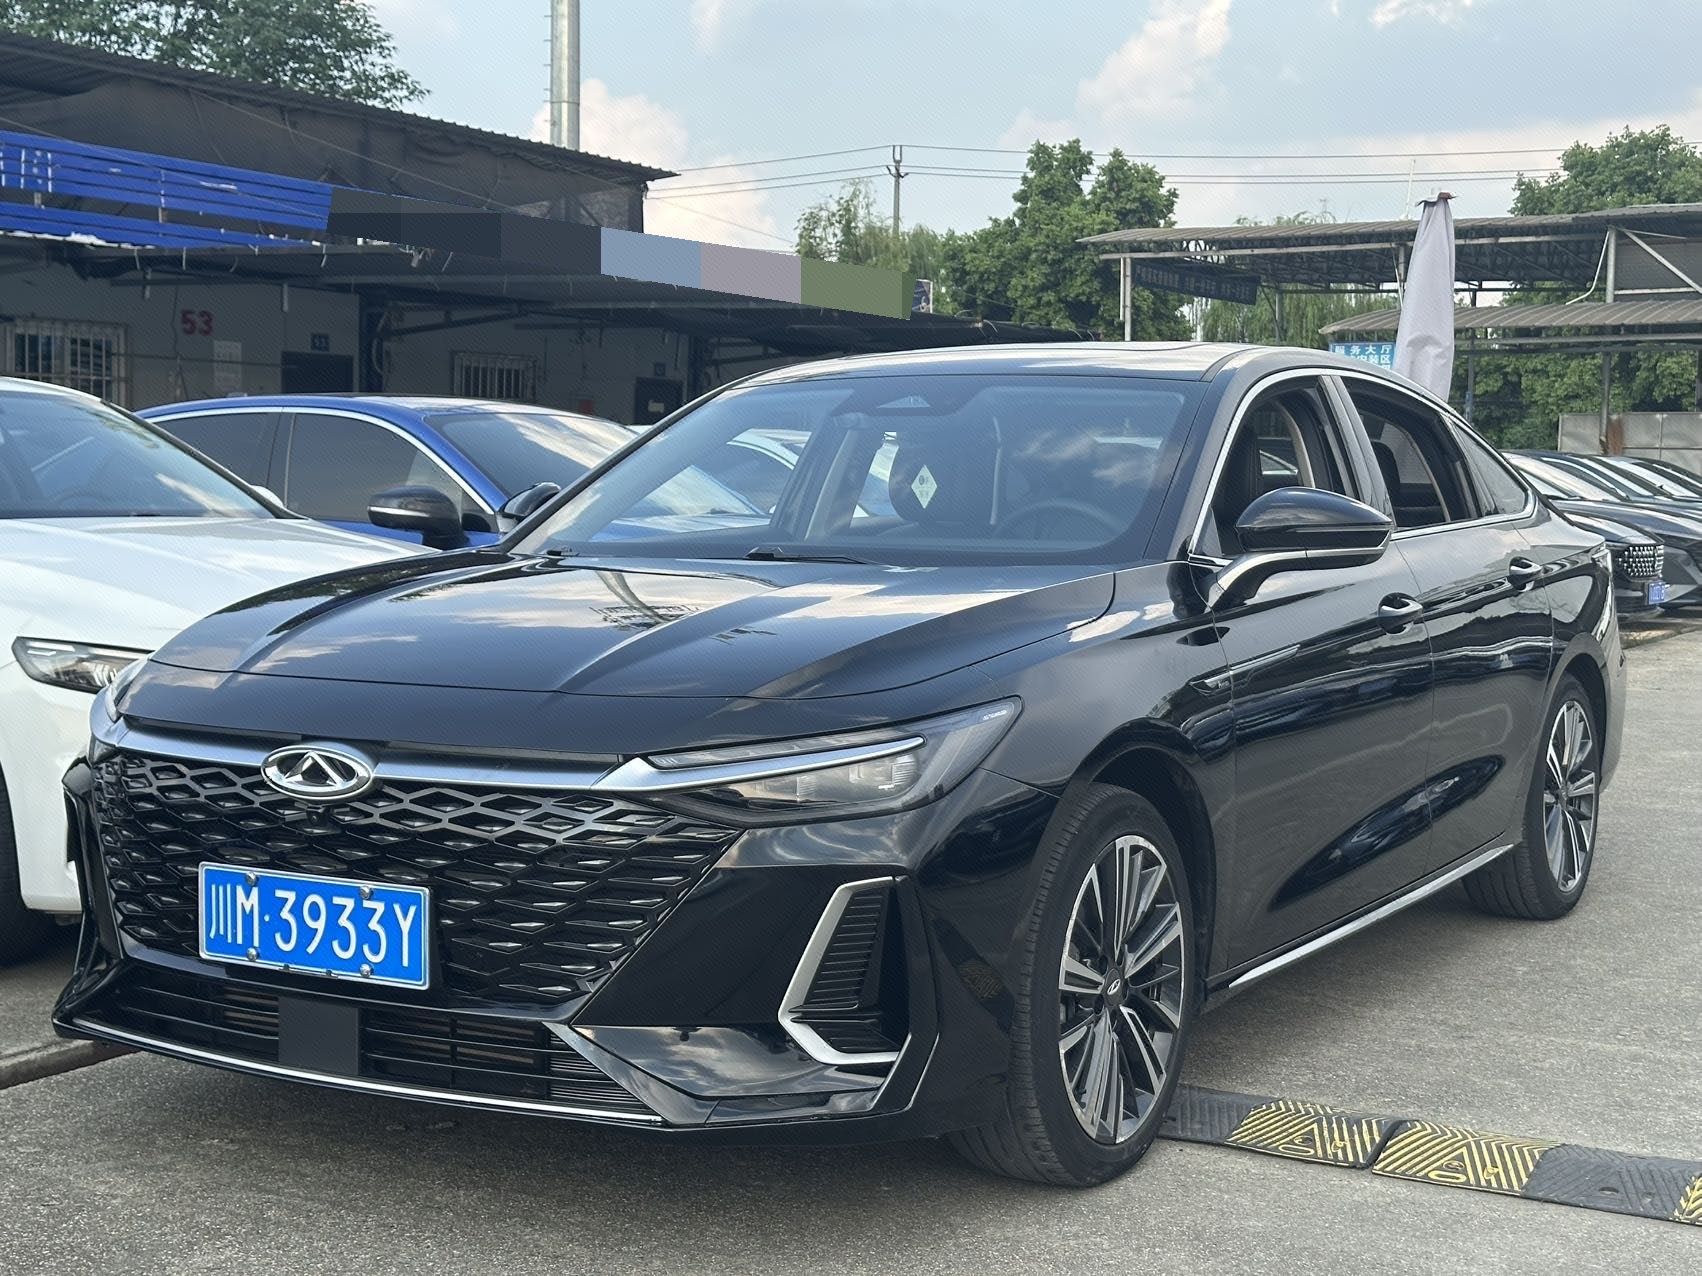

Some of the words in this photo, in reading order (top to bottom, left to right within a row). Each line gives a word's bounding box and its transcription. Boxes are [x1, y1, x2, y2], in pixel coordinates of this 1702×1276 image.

[181, 309, 215, 336] 53
[1335, 344, 1392, 355] 服务大厅
[209, 883, 417, 968] 川M·3933Y
